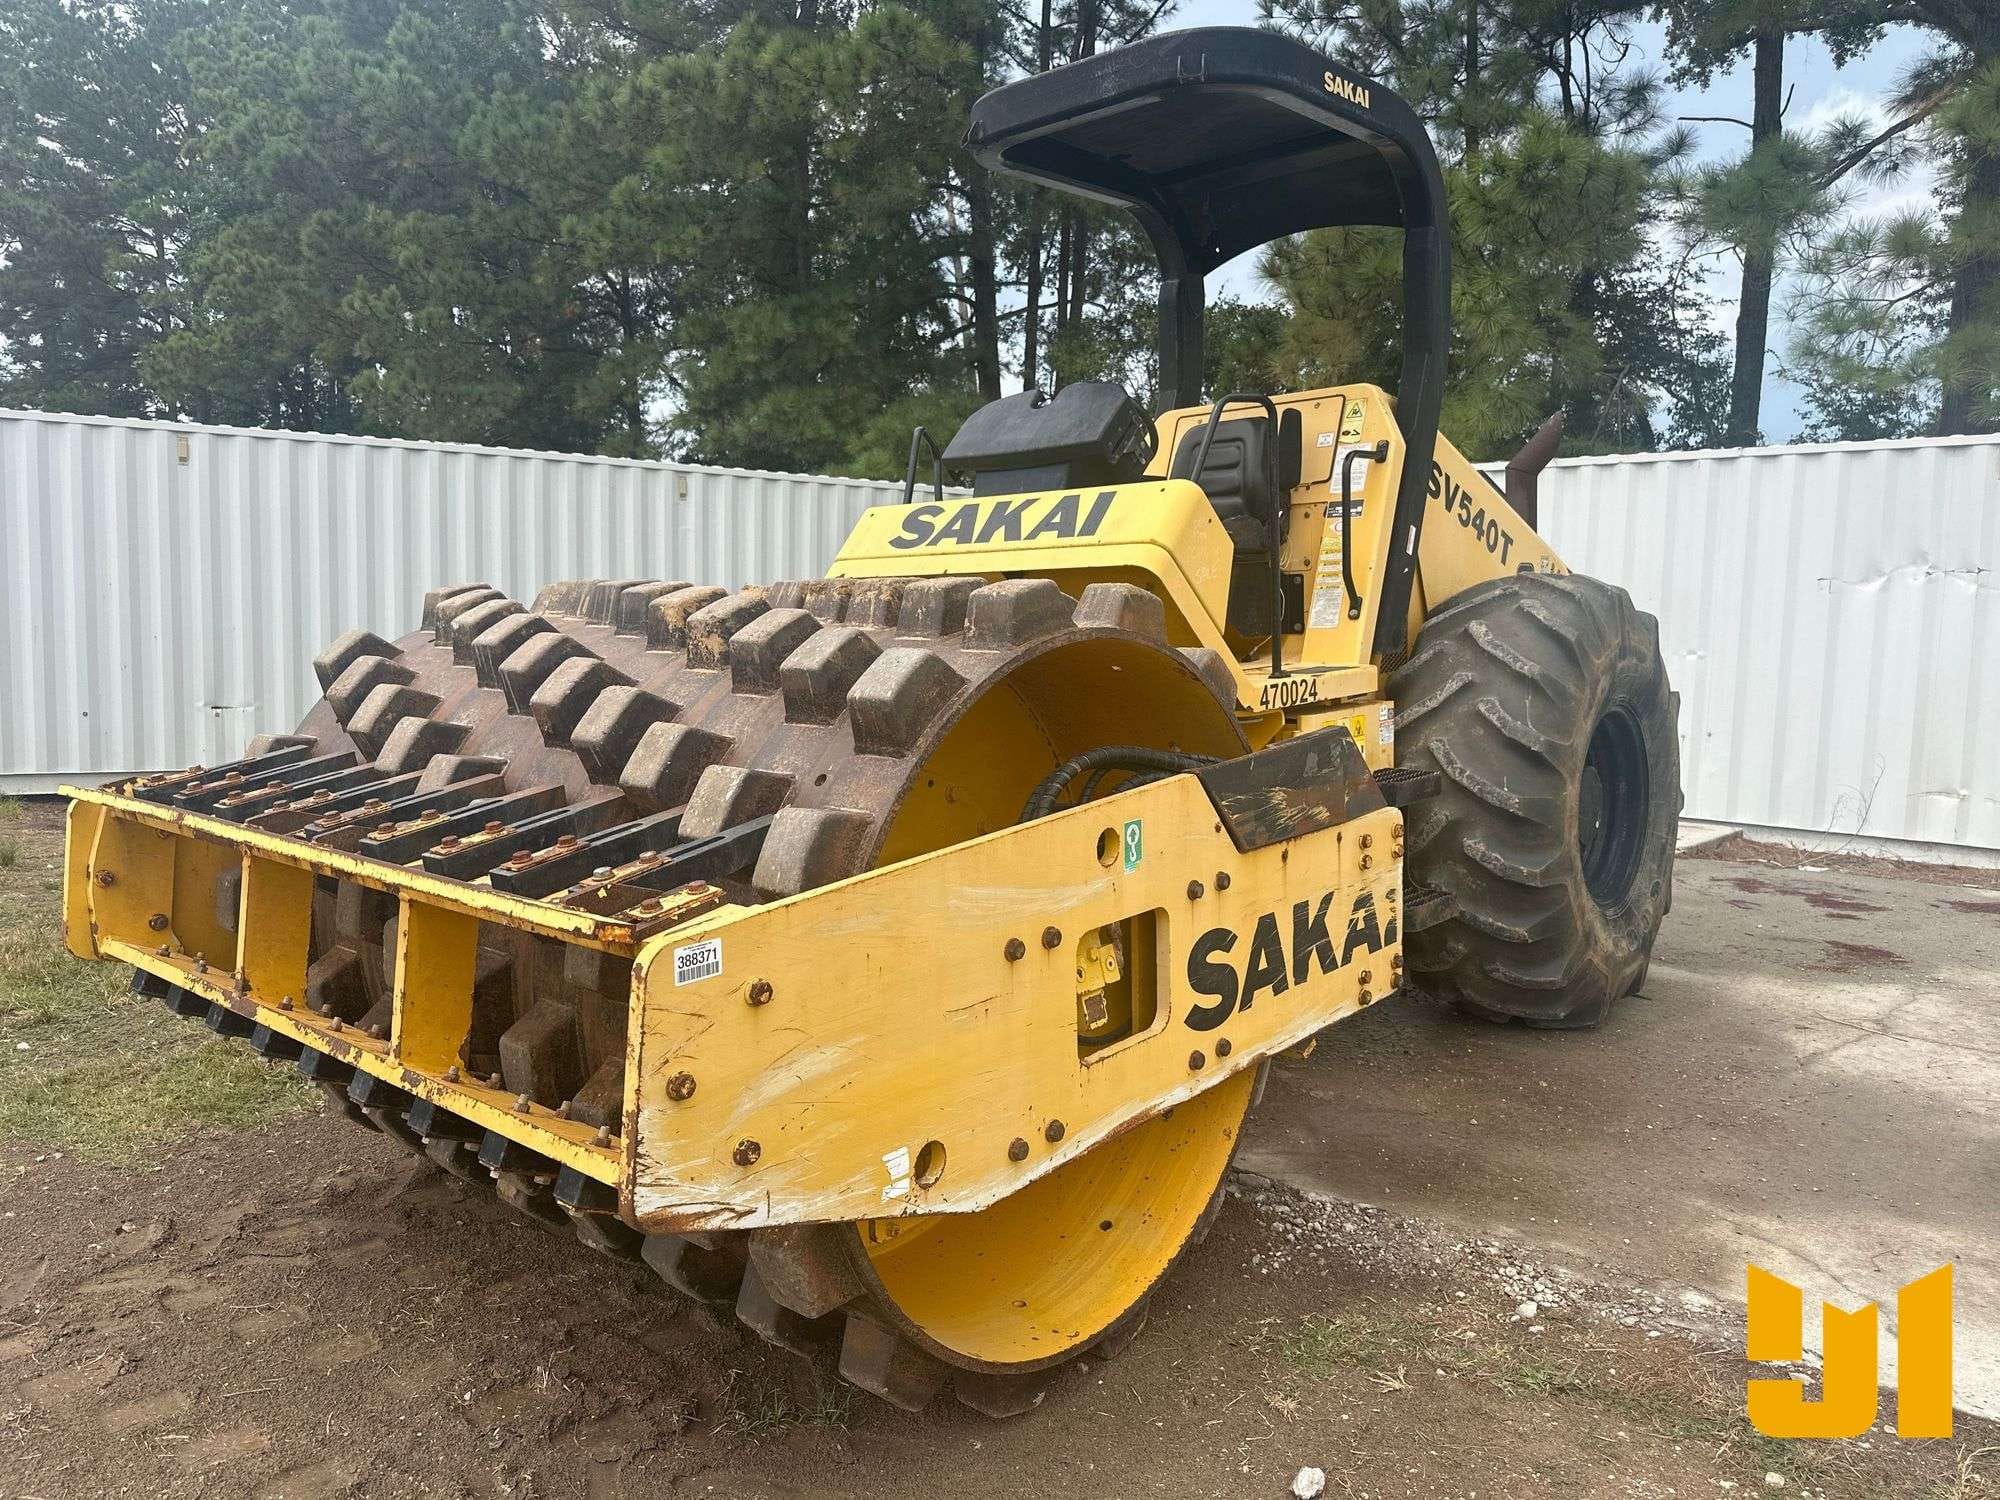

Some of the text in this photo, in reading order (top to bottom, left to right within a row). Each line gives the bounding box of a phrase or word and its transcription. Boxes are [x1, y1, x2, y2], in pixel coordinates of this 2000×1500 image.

[1323, 71, 1370, 110] SAKAI
[888, 491, 1117, 550] SAKAI
[1426, 460, 1514, 566] SV540T
[1259, 678, 1318, 710] 470024
[677, 947, 717, 970] 388371
